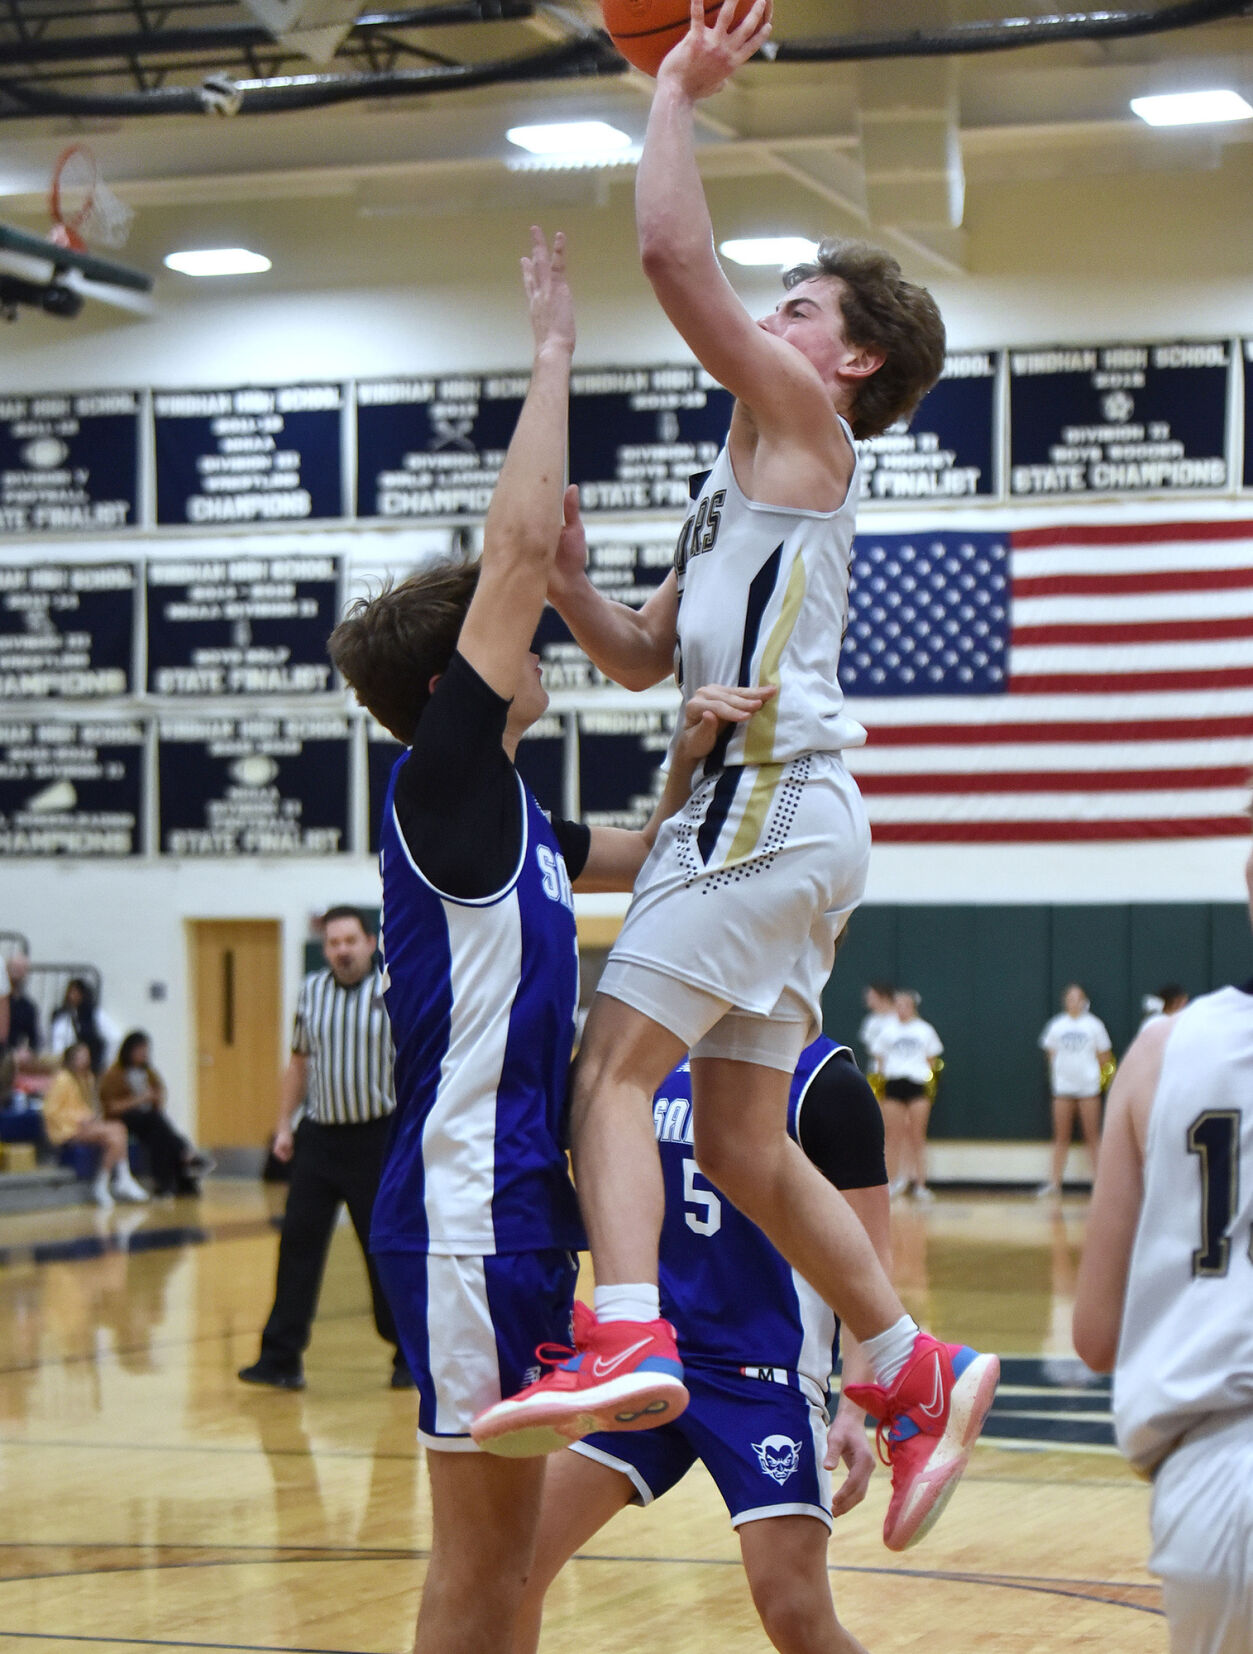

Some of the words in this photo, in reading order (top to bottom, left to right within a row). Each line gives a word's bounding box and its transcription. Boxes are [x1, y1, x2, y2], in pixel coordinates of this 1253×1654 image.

[1104, 349, 1148, 370] HIGH
[1154, 345, 1230, 368] SCHOOL
[1012, 465, 1086, 492] STATE
[1091, 458, 1226, 490] CHAMPIONS
[186, 489, 312, 522] CHAMPIONS
[580, 481, 651, 509] STATE
[682, 1158, 721, 1238] 5
[758, 1367, 775, 1383] M
